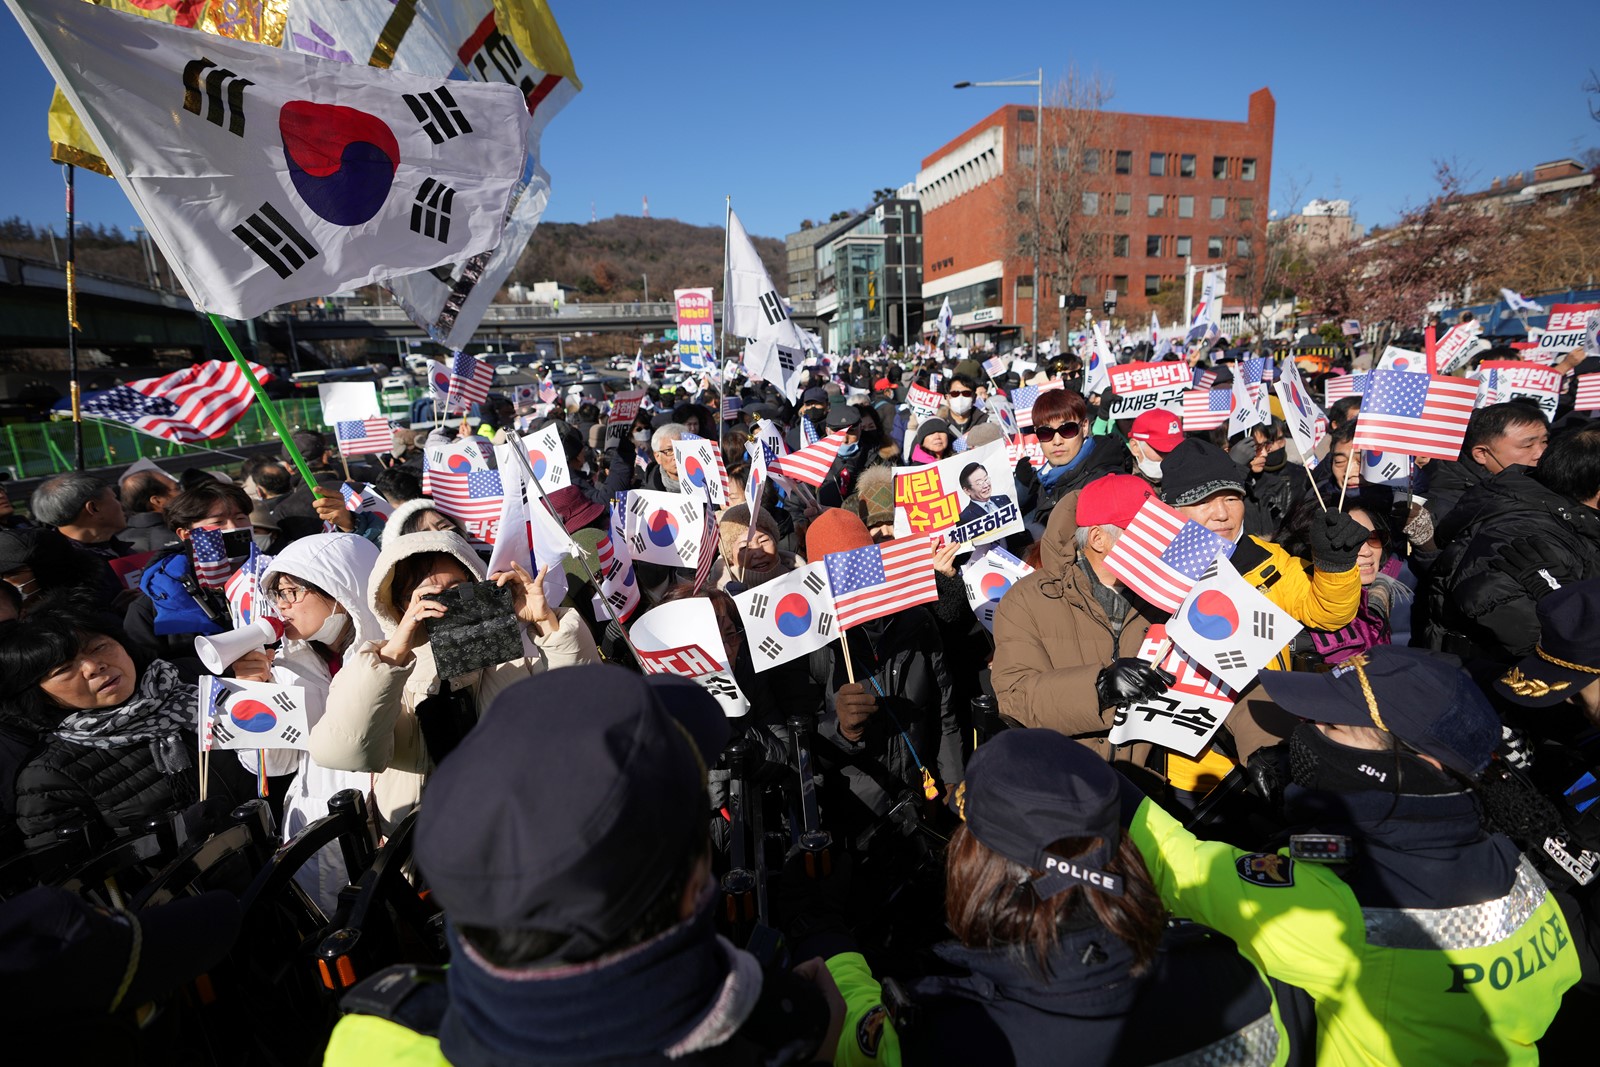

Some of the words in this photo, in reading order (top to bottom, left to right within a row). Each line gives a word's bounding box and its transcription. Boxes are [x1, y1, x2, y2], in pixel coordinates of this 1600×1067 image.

[1547, 309, 1600, 331] 탄핵
[1111, 362, 1190, 393] 탄핵반대
[1112, 392, 1158, 414] 이재명
[895, 469, 940, 504] 내란
[909, 493, 961, 532] 수괴
[949, 503, 1018, 545] 체포하라
[1134, 694, 1218, 737] 구속
[1045, 856, 1115, 890] POLICE
[1548, 842, 1589, 880] POLICE
[1443, 911, 1569, 994] POLICE
